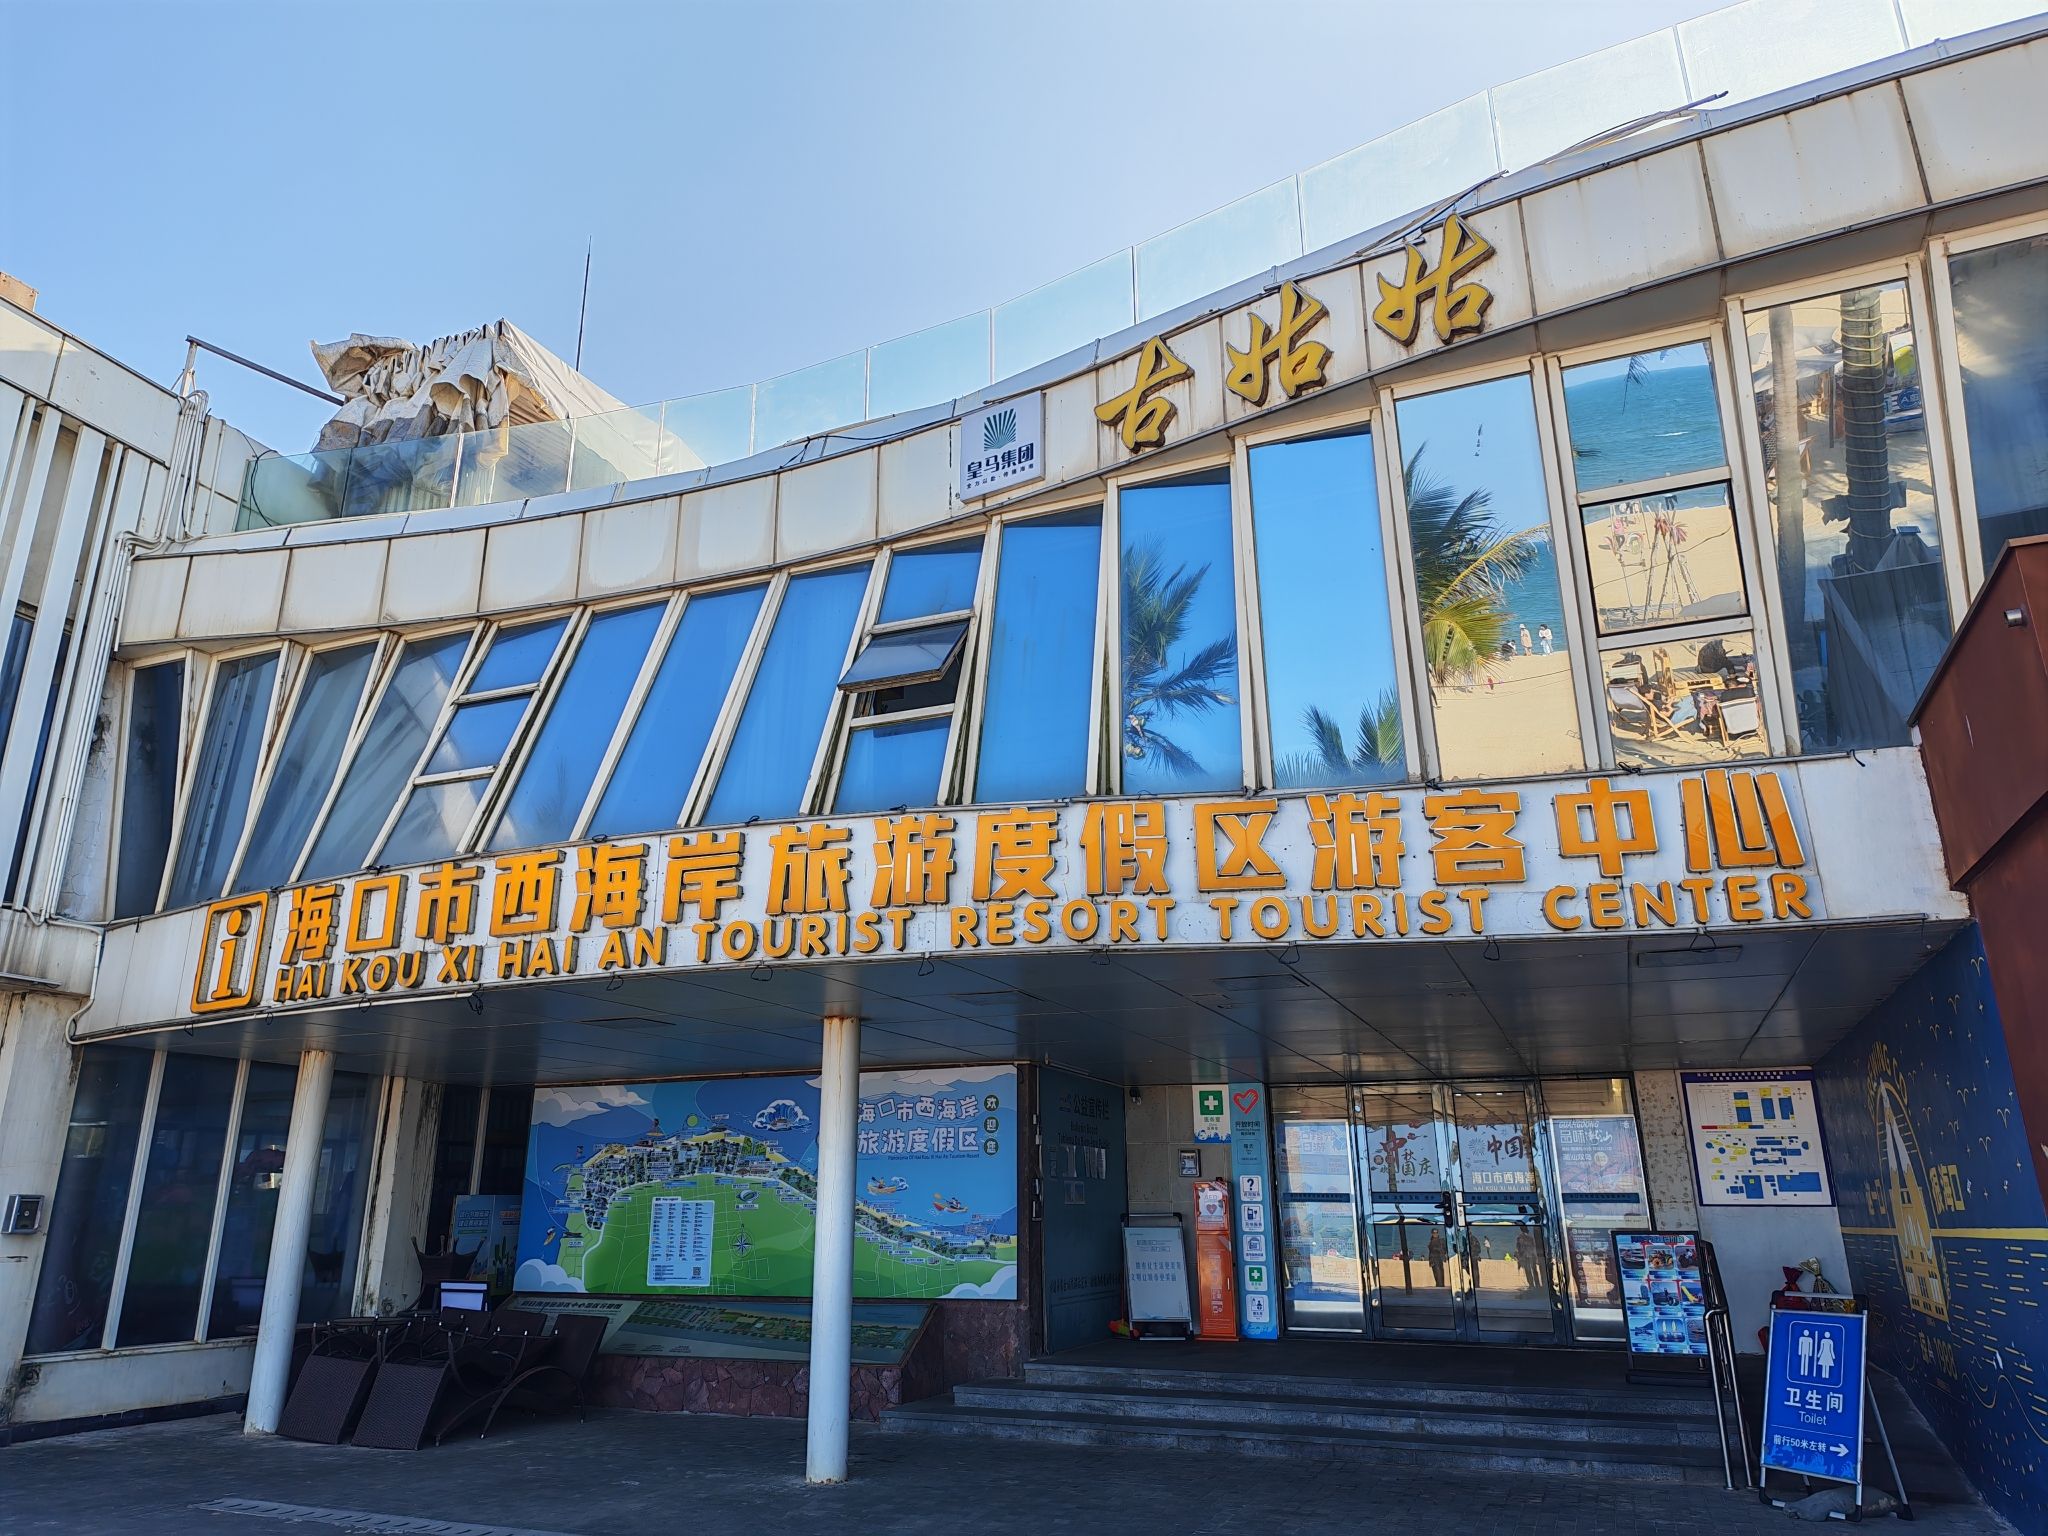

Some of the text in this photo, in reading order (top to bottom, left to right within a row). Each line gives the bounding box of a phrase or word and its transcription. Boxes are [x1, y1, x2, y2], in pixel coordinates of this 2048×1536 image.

[1094, 213, 1494, 451] 古姑姑
[966, 442, 1034, 482] 皇马集团
[279, 768, 1807, 966] 海口市西海岸旅游度假区游客中心
[273, 873, 1813, 1003] HAI KOU XI HAI AN TOURIST RESORT TOURIST CENTER
[858, 1095, 979, 1123] 海口市西海岸
[858, 1126, 979, 1154] 旅游度假区
[1487, 1134, 1524, 1166] 中国
[1401, 1157, 1435, 1176] 国庆
[1784, 1387, 1843, 1413] 卫生间
[1799, 1411, 1827, 1426] Toilet
[1773, 1434, 1827, 1453] 前行50米左转
